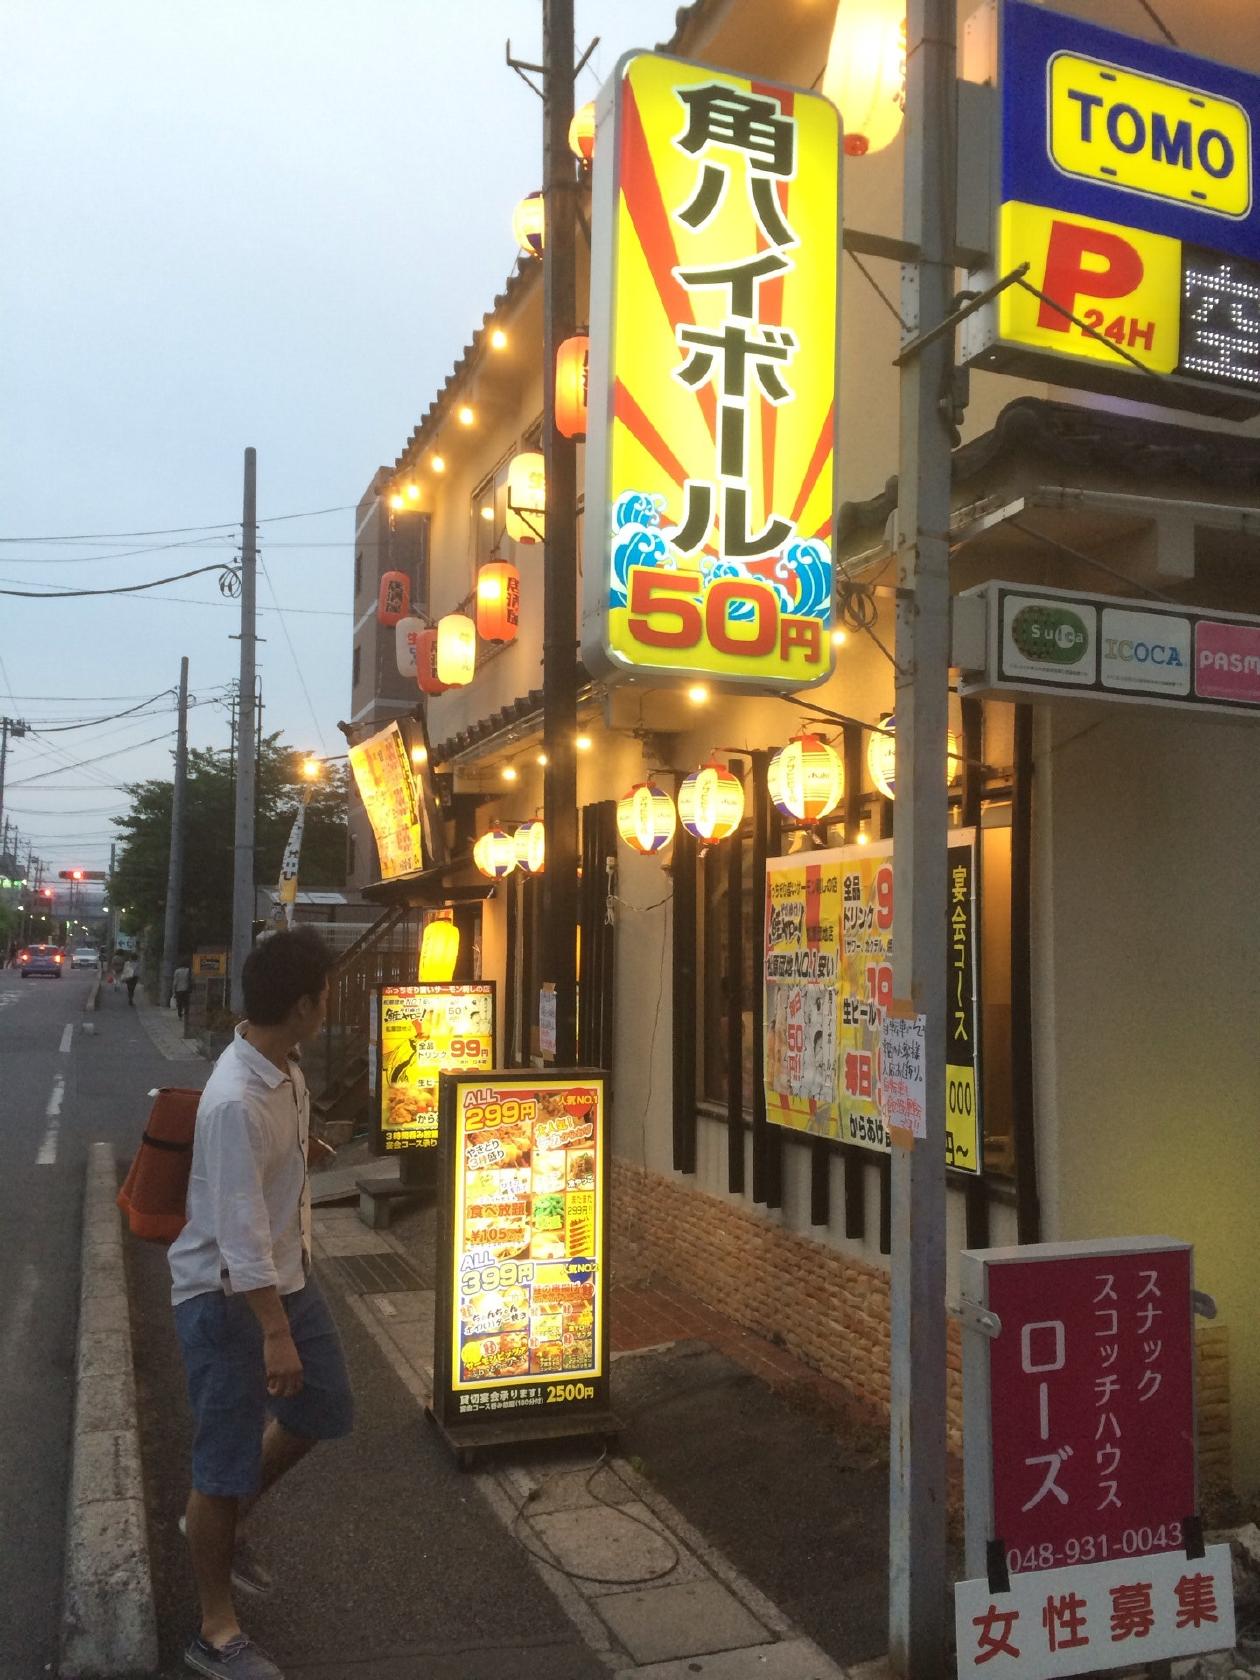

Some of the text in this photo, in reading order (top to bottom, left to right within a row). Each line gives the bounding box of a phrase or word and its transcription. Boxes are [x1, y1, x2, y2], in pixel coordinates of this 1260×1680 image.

[1067, 88, 1236, 179] TOMO
[1036, 220, 1145, 334] P
[674, 83, 797, 557] 角ハイボール
[1083, 308, 1156, 352] 24H
[627, 570, 821, 666] 50円
[1031, 624, 1084, 648] Suica
[1104, 638, 1183, 667] ICOCA
[843, 875, 860, 902] 全品
[843, 904, 875, 930] ドリンク
[951, 864, 970, 1041] 宴会コース
[843, 998, 877, 1028] 生ビール
[418, 1042, 434, 1051] 全品
[450, 1039, 489, 1058] 99円
[787, 1023, 803, 1053] 50
[844, 1051, 873, 1098] 毎日
[463, 1087, 499, 1108] ALL
[417, 1114, 439, 1125] から
[464, 1099, 538, 1132] 299円
[467, 1140, 500, 1159] やきとり
[469, 1200, 527, 1218] 食べ放題
[460, 1250, 495, 1272] ALL
[461, 1262, 535, 1296] 399円
[1136, 1269, 1164, 1403] スナック
[460, 1387, 542, 1406] 貸切宴会承ります!
[546, 1383, 594, 1403] 2500円
[1092, 1273, 1123, 1512] スコッチハウス
[1020, 1319, 1074, 1513] ローズ
[1006, 1521, 1183, 1573] 048-931-0043
[971, 1573, 1220, 1666] 女性募集
